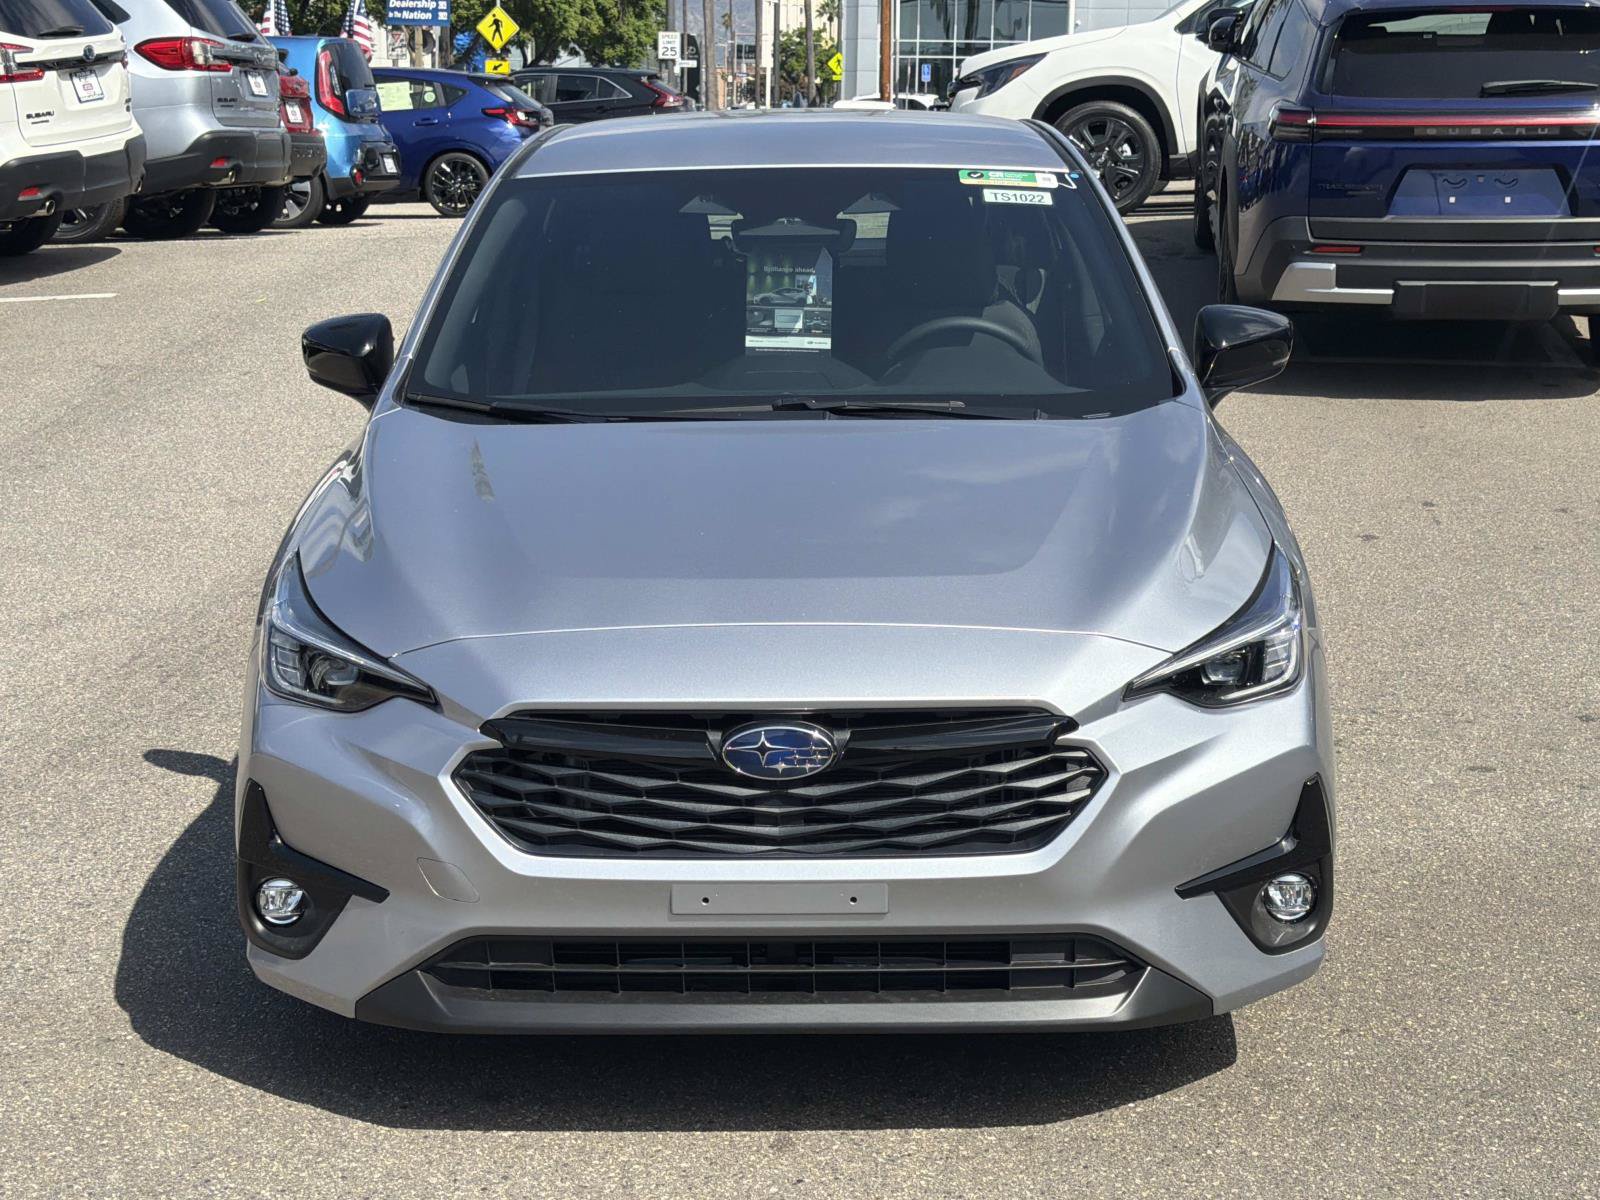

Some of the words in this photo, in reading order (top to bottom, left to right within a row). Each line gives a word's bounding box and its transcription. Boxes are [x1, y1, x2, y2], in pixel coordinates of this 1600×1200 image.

[388, 0, 437, 10] Dealership
[402, 10, 432, 19] Nation
[661, 46, 678, 56] 25
[26, 111, 55, 119] SUBARU
[1426, 127, 1549, 135] SUBARU
[991, 192, 1045, 203] TS1022
